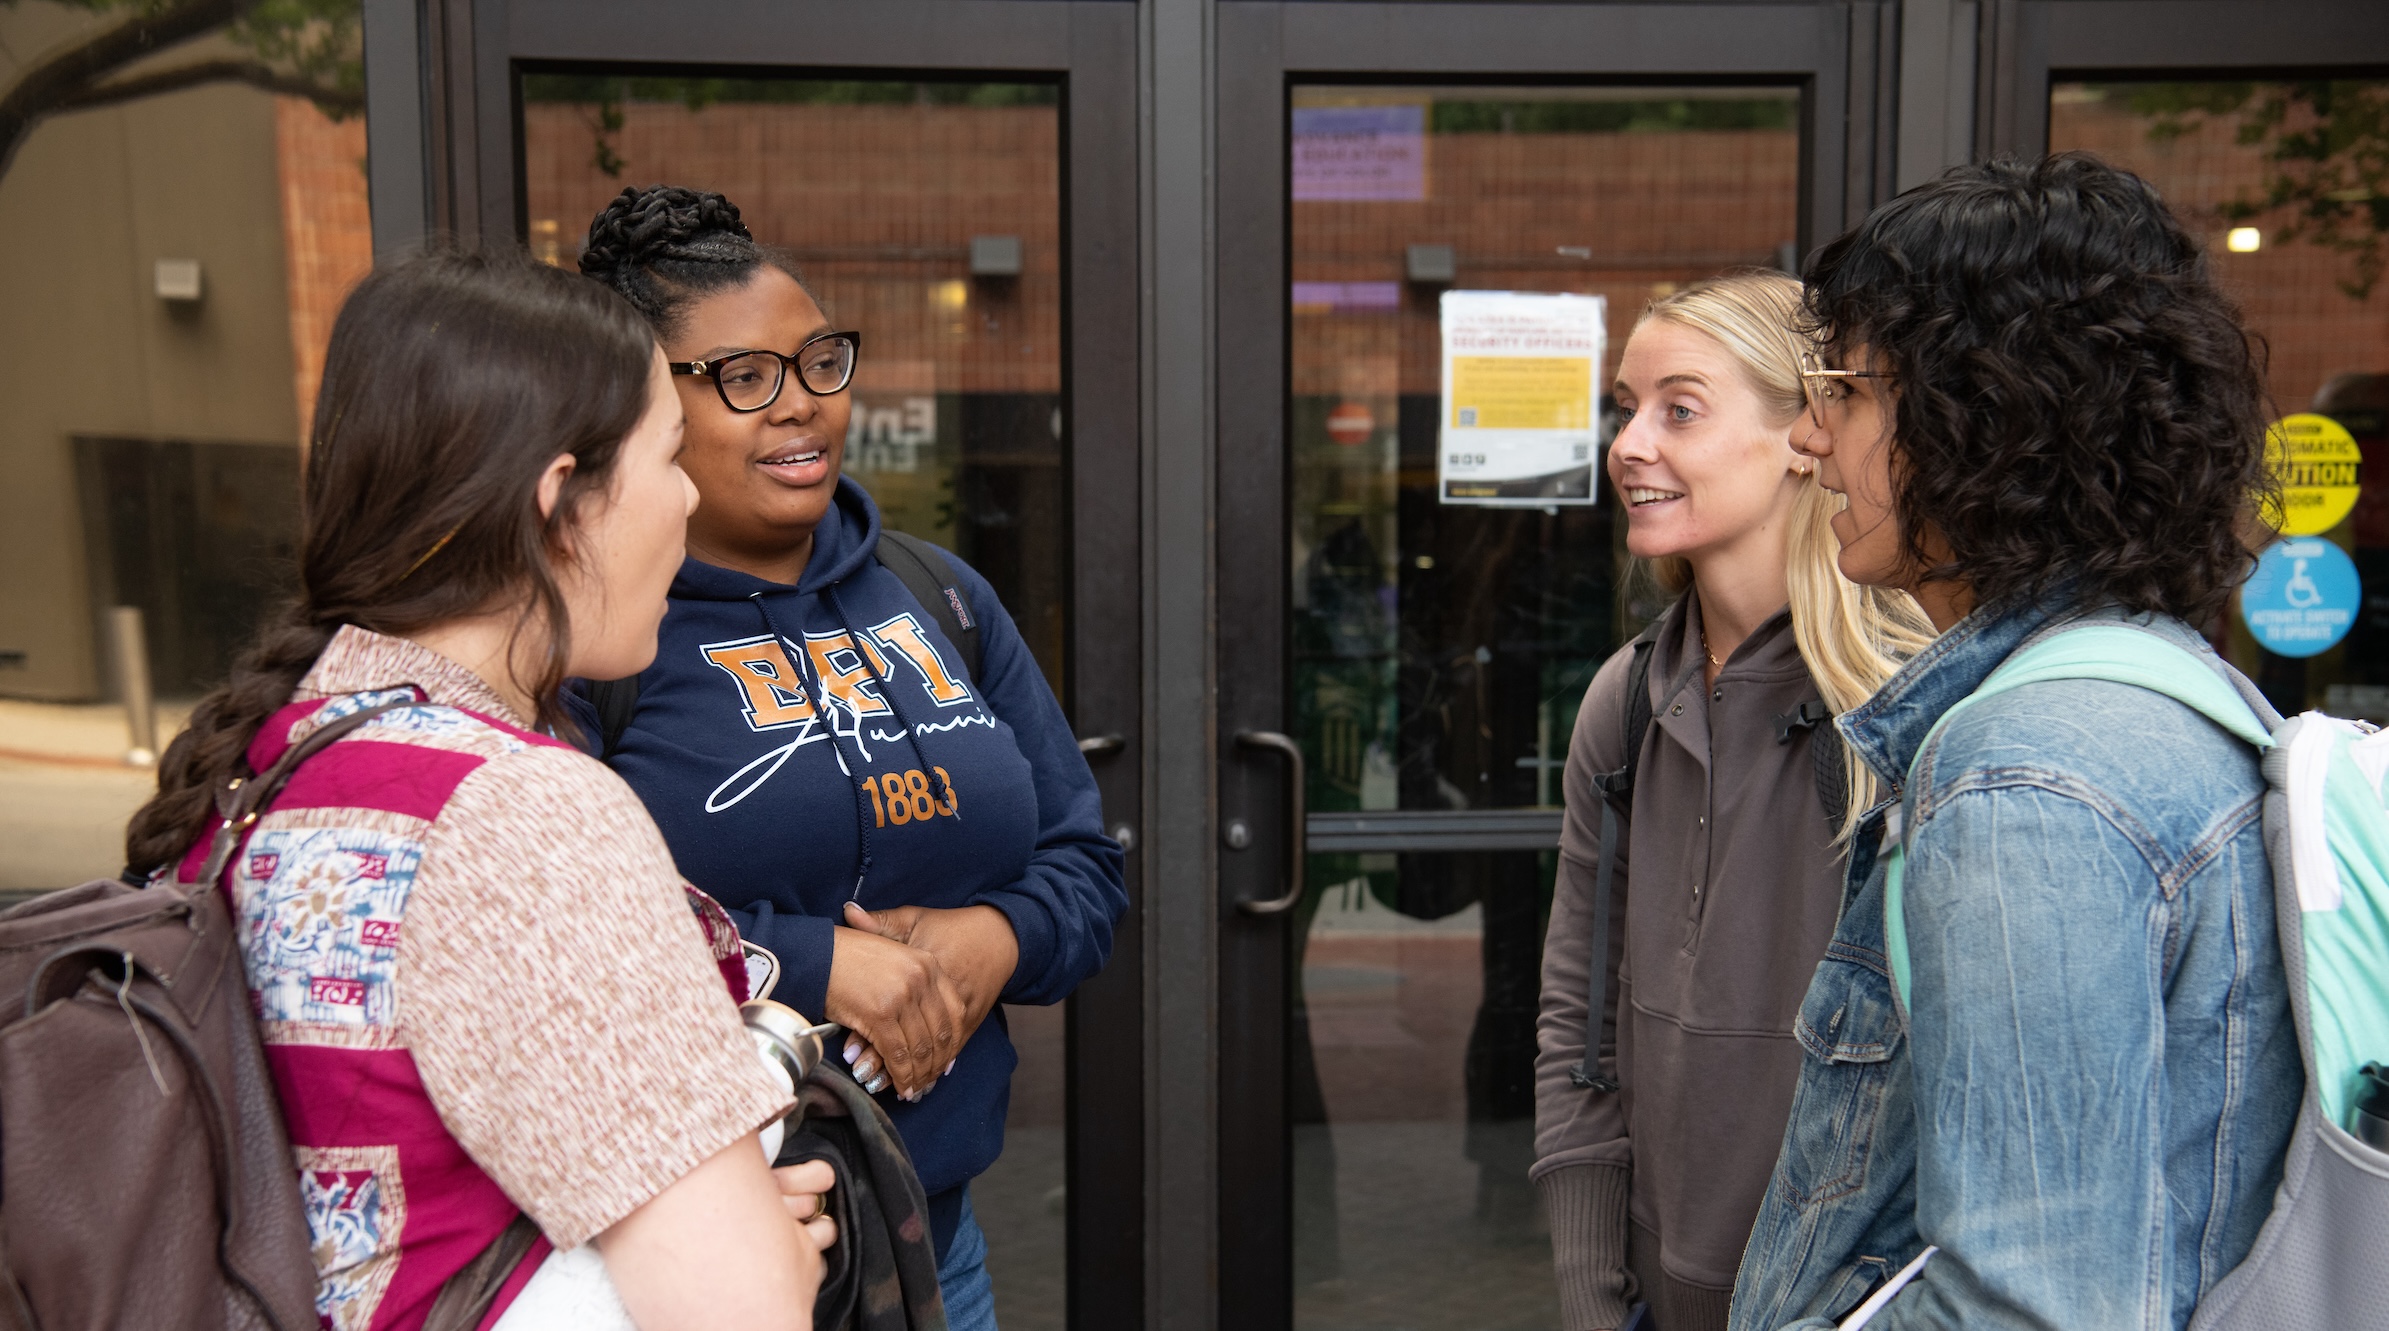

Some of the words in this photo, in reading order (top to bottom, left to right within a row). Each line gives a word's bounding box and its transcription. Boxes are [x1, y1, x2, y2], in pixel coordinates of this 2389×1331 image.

[1453, 337, 1519, 348] SECURITY
[1525, 337, 1592, 349] OFFICERS
[2251, 610, 2302, 625] ACTIVATE
[2305, 608, 2350, 625] SWITCH
[2265, 625, 2281, 640] TO
[2284, 626, 2331, 640] OPERATE
[861, 765, 959, 828] 1883
